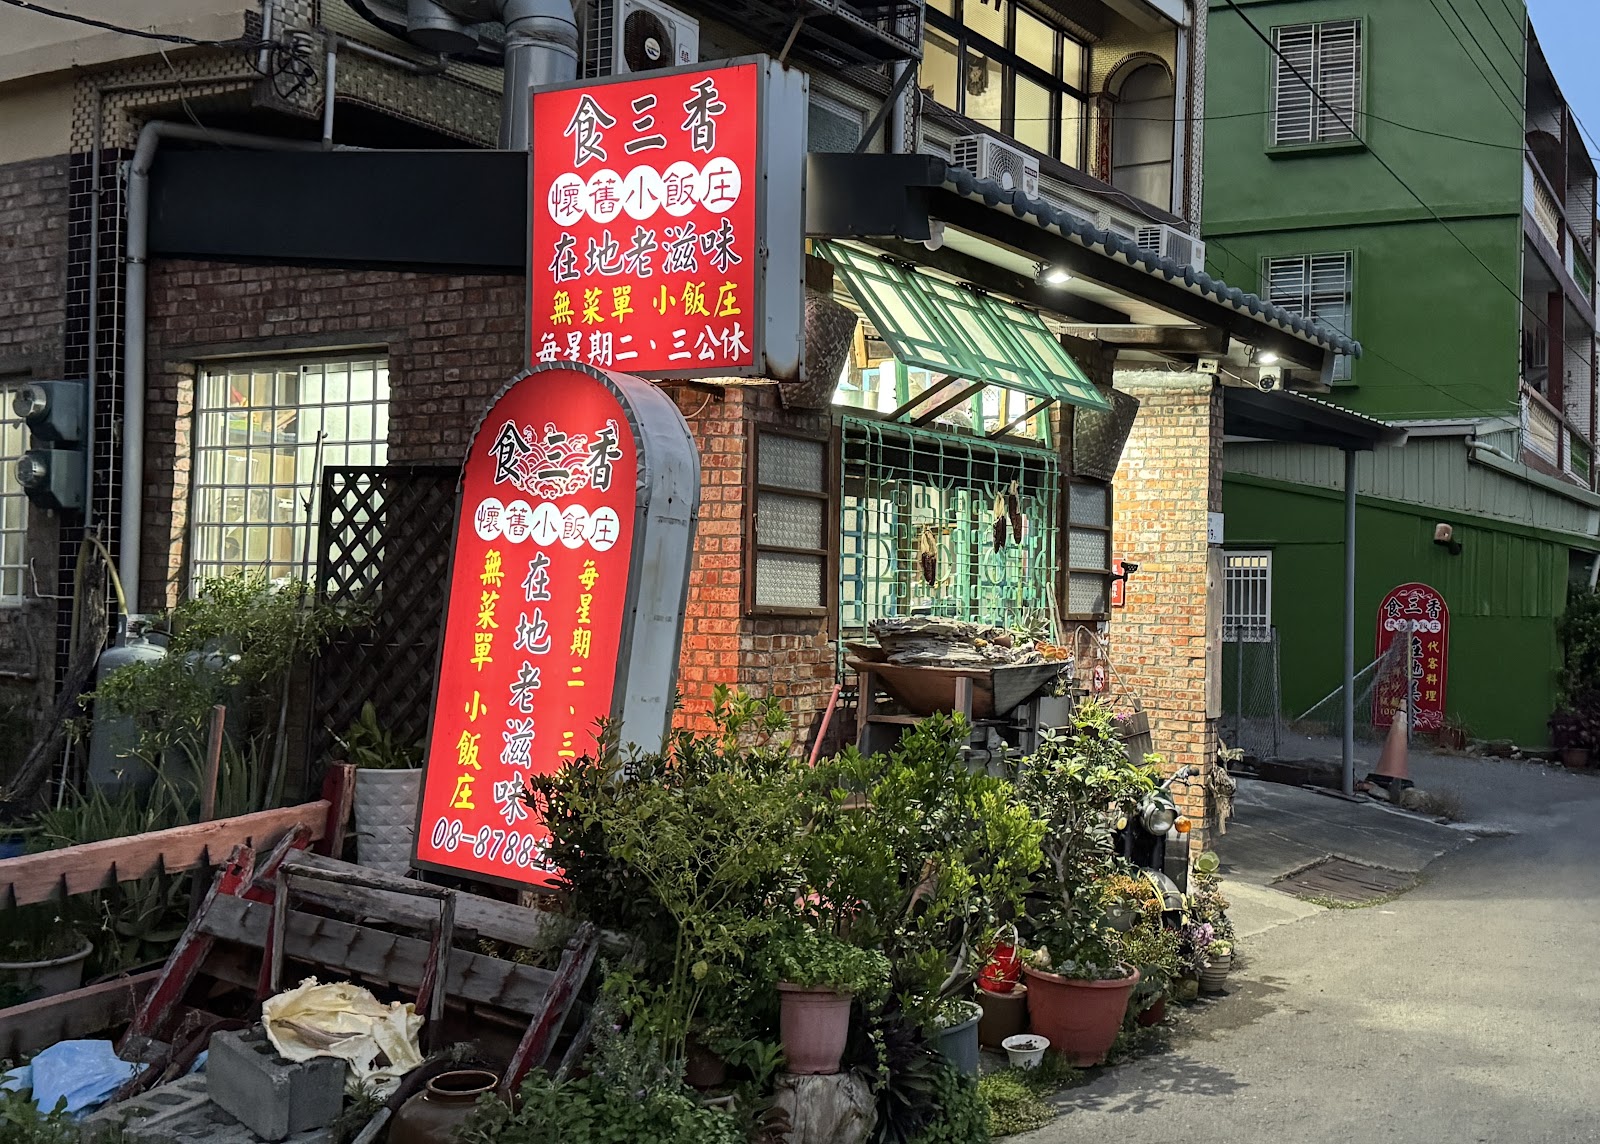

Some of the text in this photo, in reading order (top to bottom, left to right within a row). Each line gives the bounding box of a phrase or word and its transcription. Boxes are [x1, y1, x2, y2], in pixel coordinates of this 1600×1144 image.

[564, 77, 726, 168] 食三香
[550, 164, 738, 220] 懷舊小飯庄
[548, 217, 743, 284] 在地老滋味
[549, 280, 742, 326] 無菜單 小飯庄
[535, 321, 750, 368] 每星期二、三公休
[488, 421, 622, 491] 食三香
[477, 501, 618, 545] 懷舊小飯庄
[1384, 597, 1442, 619] 食三香
[449, 549, 505, 811] 無菜單 小飯庄
[493, 551, 551, 826] 在地老滋味
[552, 559, 600, 815] 每星期二、三
[1425, 640, 1440, 702] 代客料理
